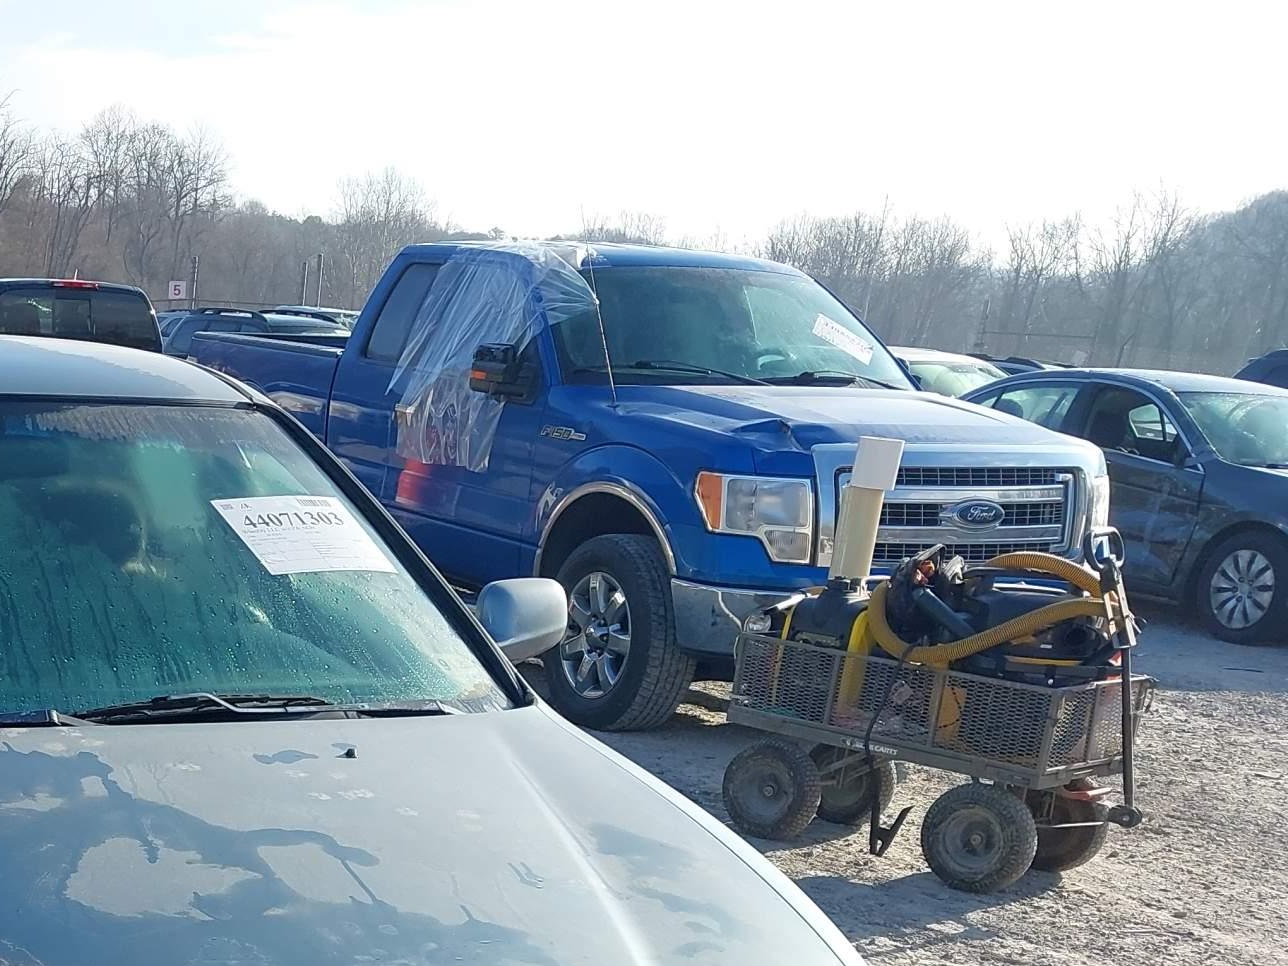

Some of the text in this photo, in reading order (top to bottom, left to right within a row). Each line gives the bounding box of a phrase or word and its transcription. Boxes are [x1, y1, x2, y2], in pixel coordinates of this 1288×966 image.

[173, 284, 181, 296] 5
[244, 511, 344, 528] 44071303
[967, 505, 996, 521] Ford
